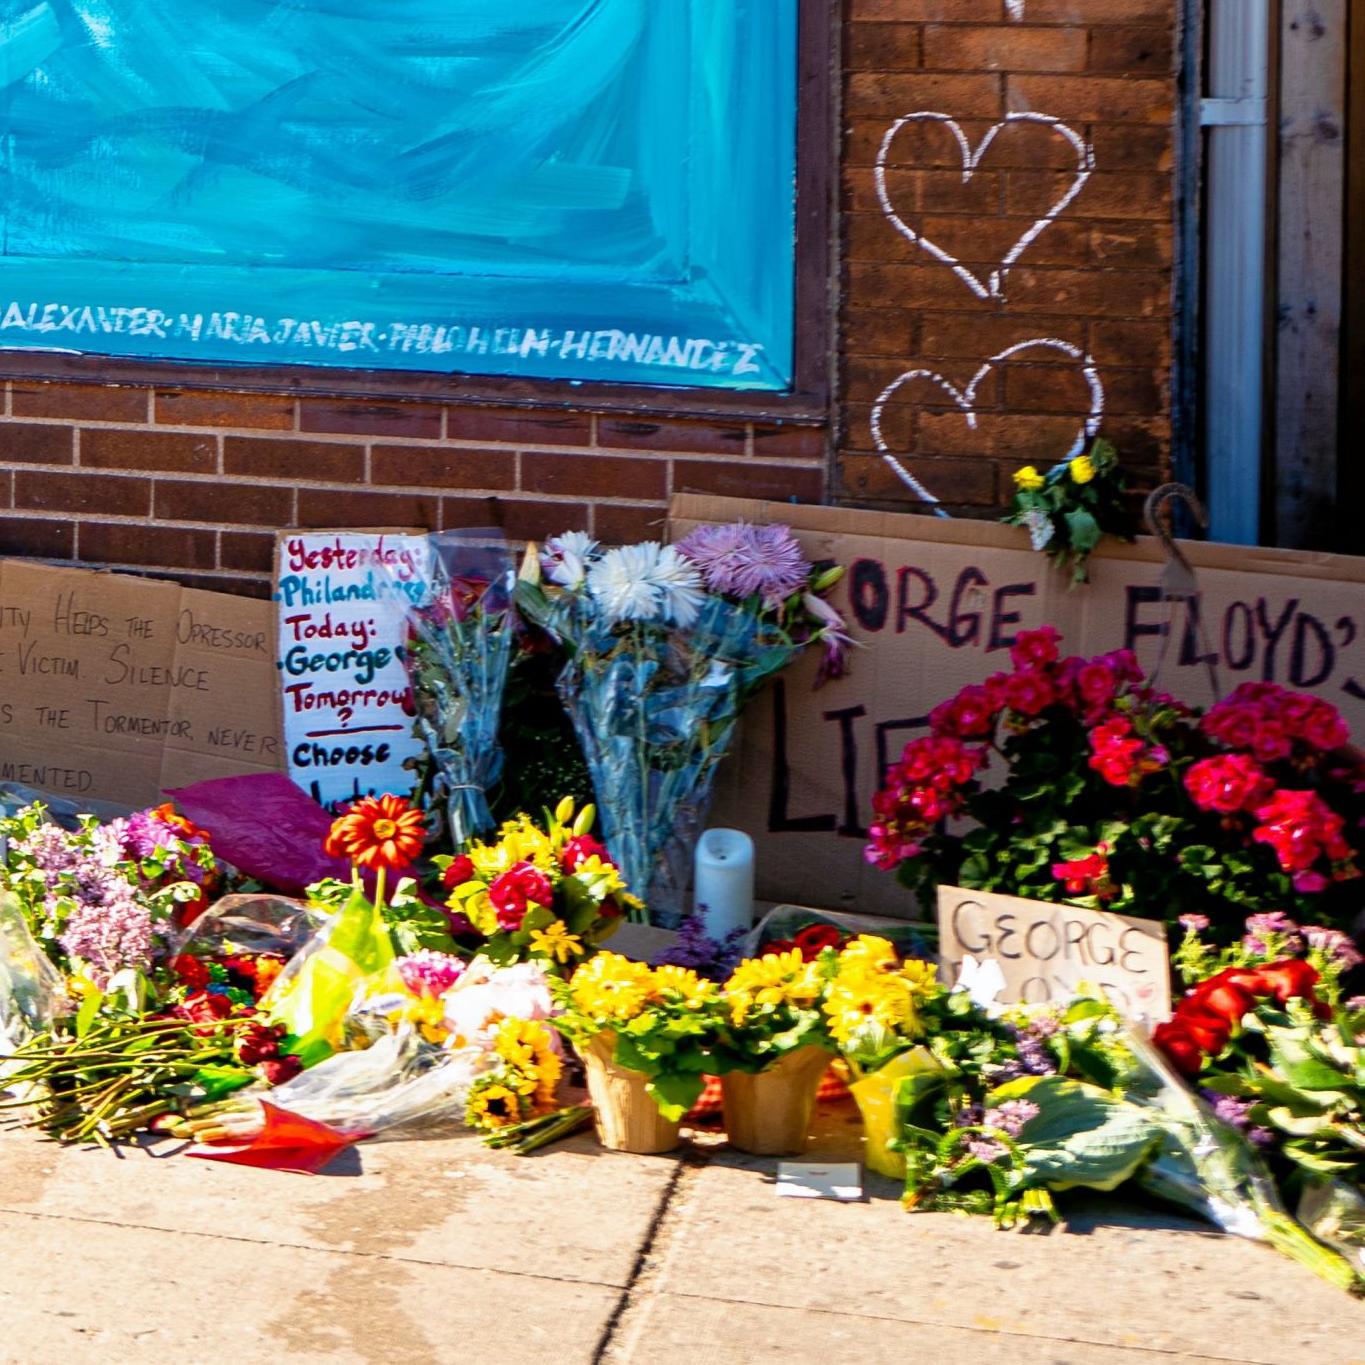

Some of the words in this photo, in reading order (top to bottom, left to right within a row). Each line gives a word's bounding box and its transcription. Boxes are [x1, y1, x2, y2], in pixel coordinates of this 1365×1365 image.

[279, 572, 402, 607] Philand
[126, 616, 154, 639] THE
[284, 613, 377, 651] Today:
[814, 556, 1037, 652] ORGE
[1124, 584, 1365, 701] FLOYD'
[105, 643, 210, 692] SILENCE
[284, 645, 391, 685] George
[36, 706, 71, 729] THE
[953, 899, 1150, 974] GEORGE
